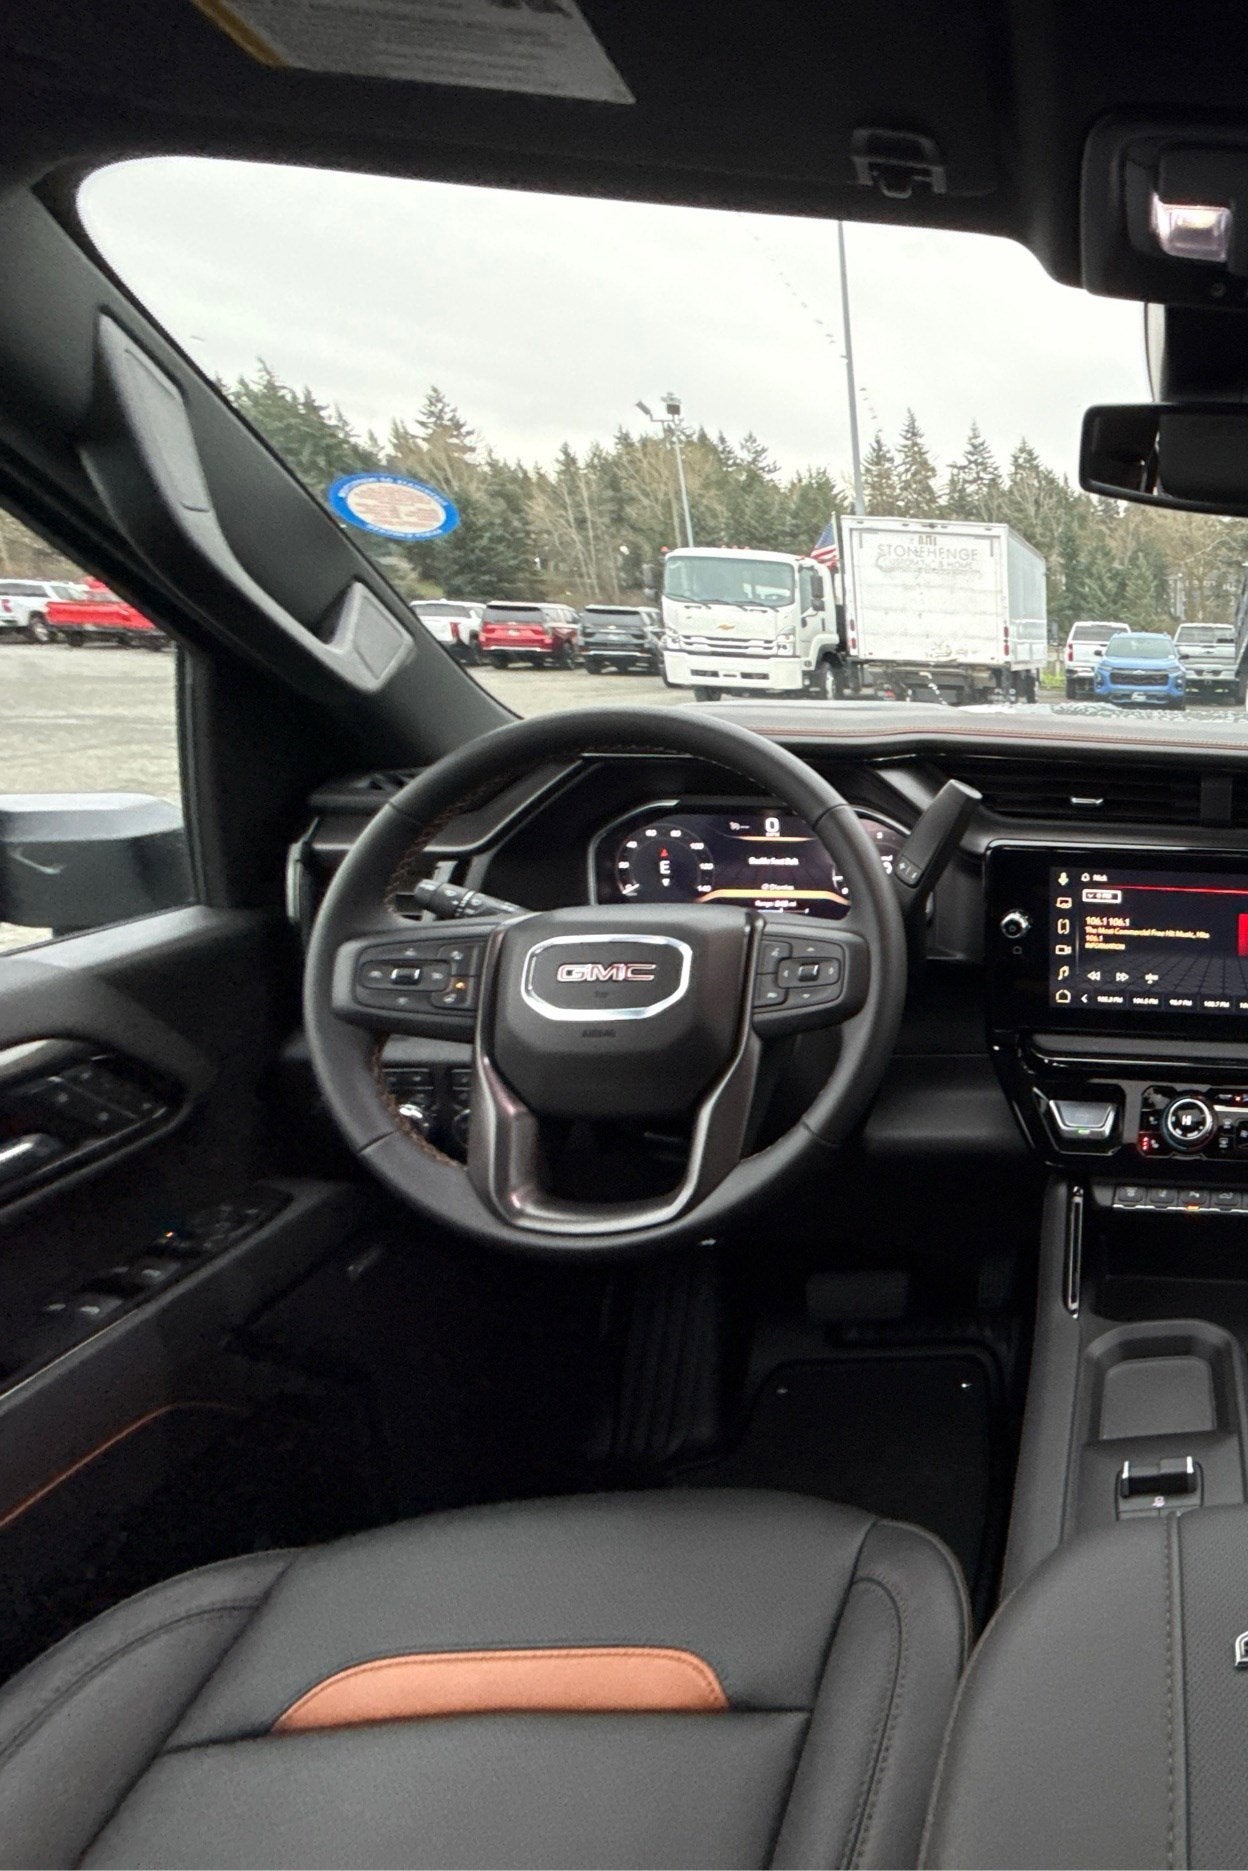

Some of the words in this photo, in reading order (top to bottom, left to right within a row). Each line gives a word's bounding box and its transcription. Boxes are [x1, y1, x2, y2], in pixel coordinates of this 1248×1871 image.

[877, 543, 979, 561] STONEHENGE
[765, 817, 780, 833] 0
[659, 860, 671, 875] E
[557, 963, 657, 982] GMC
